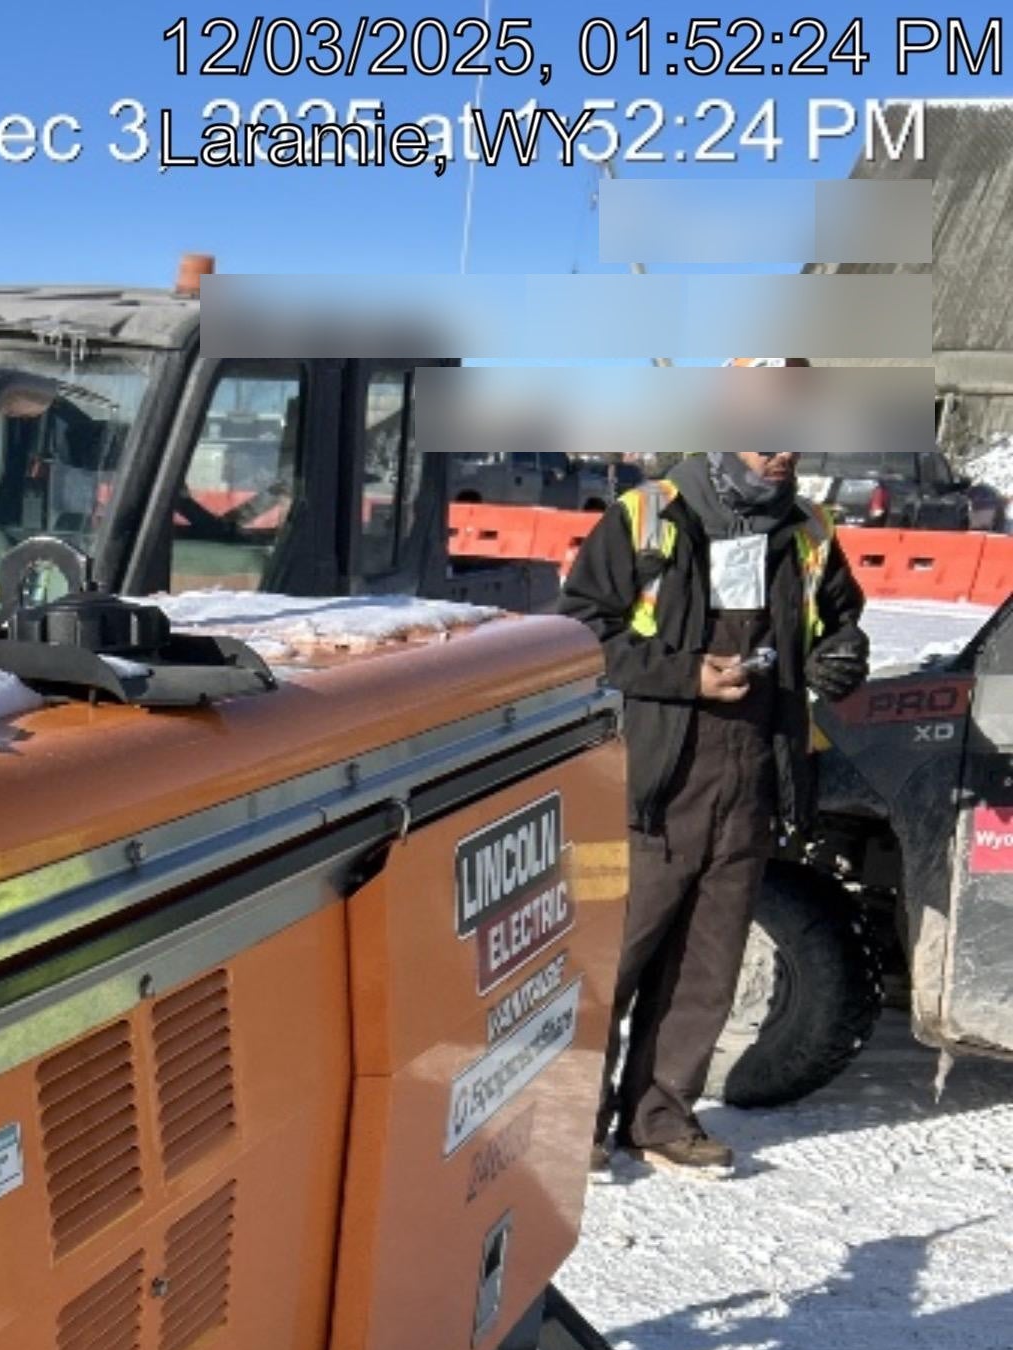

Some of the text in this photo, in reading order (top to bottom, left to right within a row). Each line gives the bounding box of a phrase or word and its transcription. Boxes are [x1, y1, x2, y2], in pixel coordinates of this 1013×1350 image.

[868, 687, 958, 719] PRO
[913, 723, 955, 742] XD
[975, 830, 1013, 850] Wyo
[462, 809, 556, 921] LINCOLN
[489, 880, 568, 972] ELECTRIC
